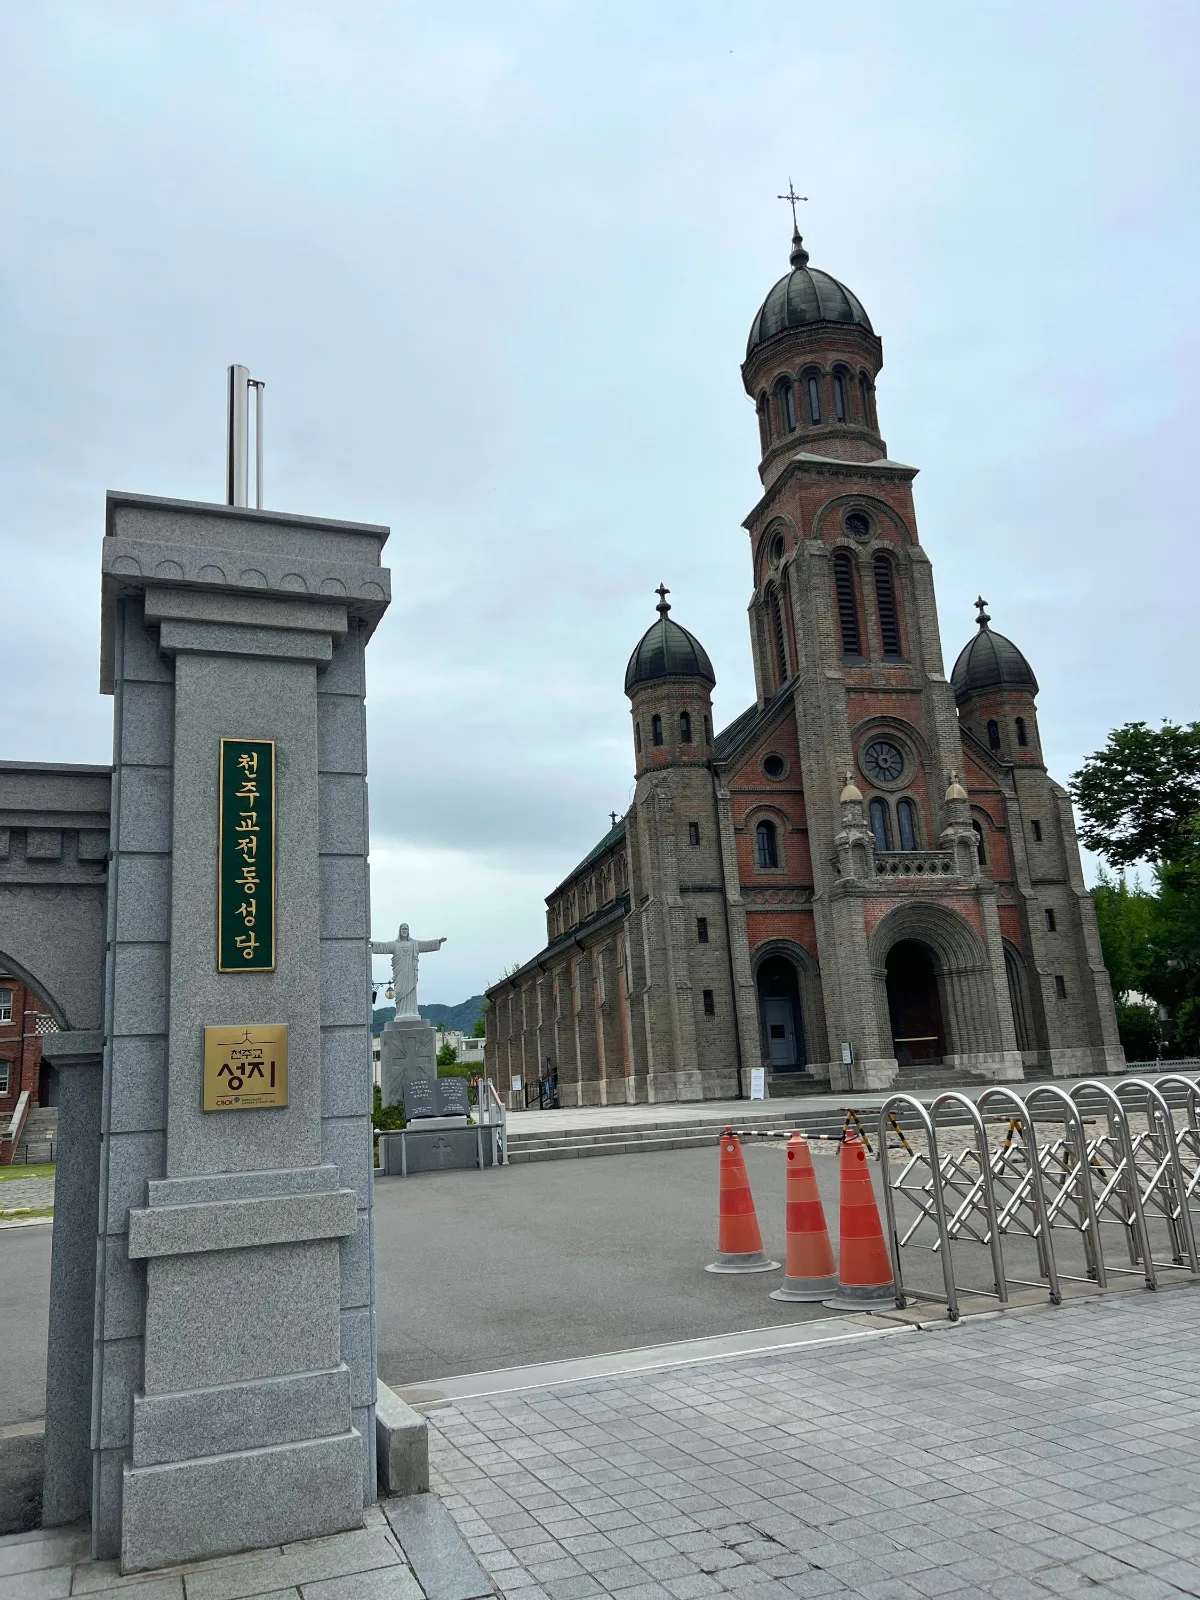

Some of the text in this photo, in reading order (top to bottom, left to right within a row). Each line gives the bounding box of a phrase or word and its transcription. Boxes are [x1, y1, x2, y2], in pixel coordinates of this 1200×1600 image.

[234, 751, 261, 960] 천주교전동성당
[230, 1048, 263, 1060] 천주교
[216, 1060, 276, 1091] 성지
[215, 1099, 234, 1107] CBCK
